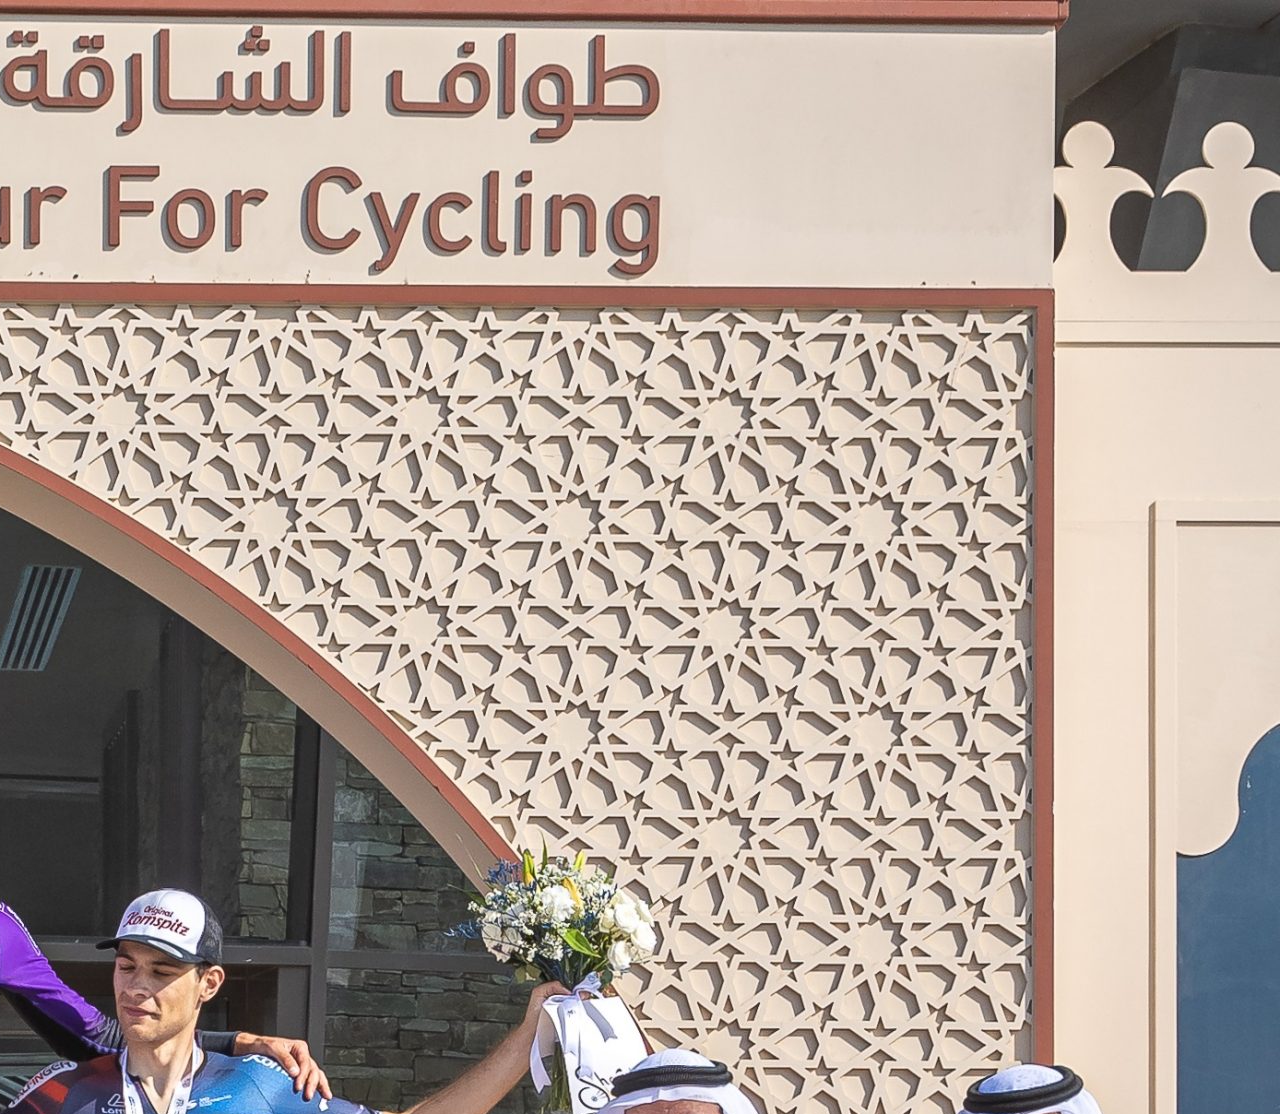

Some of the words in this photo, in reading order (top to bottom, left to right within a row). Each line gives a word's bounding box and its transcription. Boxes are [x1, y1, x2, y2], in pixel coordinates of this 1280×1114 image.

[0, 25, 352, 136] الشارقة
[388, 33, 661, 141] طواف
[107, 166, 269, 250] For
[303, 167, 660, 277] Cycling
[143, 905, 174, 918] Original
[13, 1061, 73, 1104] ALFINGER
